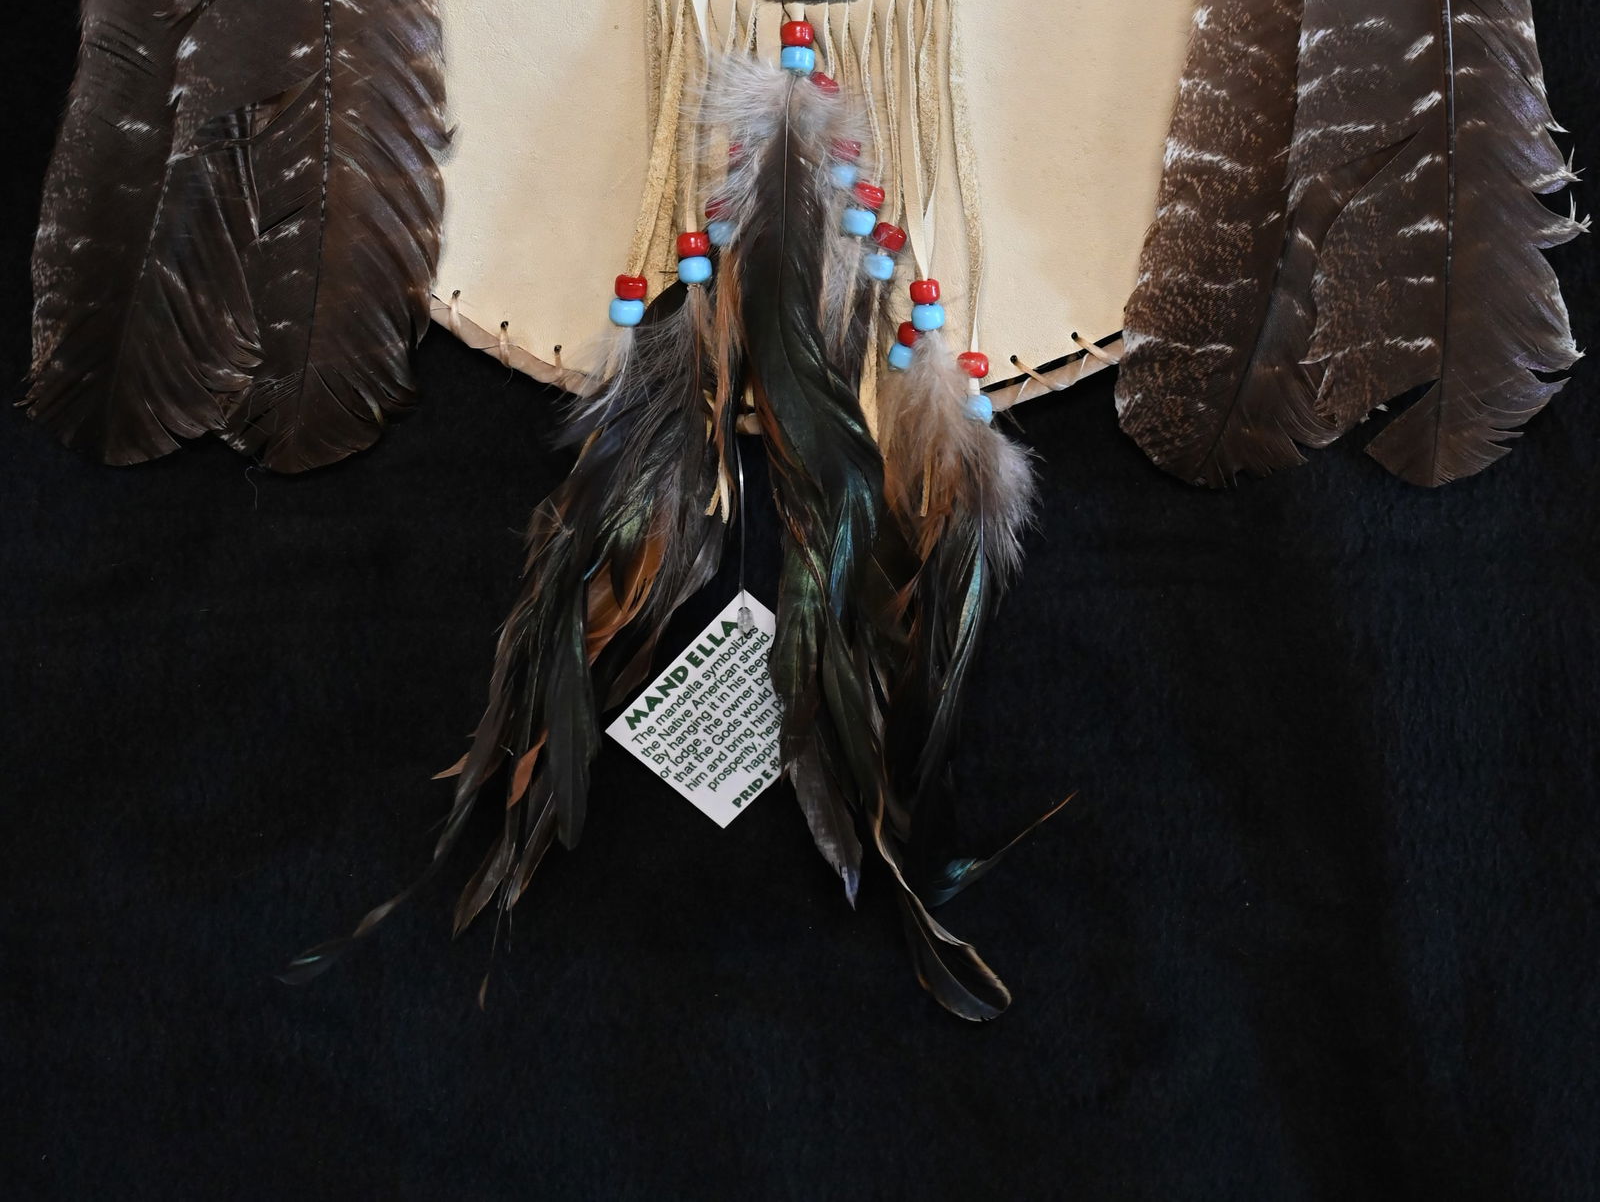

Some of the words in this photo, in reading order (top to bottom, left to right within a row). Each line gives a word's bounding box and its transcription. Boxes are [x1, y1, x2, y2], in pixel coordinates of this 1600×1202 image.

[625, 621, 738, 730] MANDELLA
[632, 726, 656, 745] The
[656, 680, 704, 726] mandella
[702, 626, 759, 681] symbolizes
[641, 741, 660, 758] the
[658, 709, 693, 741] Native
[692, 663, 741, 710] American
[739, 632, 773, 664] shield.
[652, 749, 671, 765] By
[667, 710, 712, 751] hanging
[707, 701, 719, 711] it
[715, 692, 730, 703] in
[727, 676, 746, 693] his
[660, 766, 672, 779] or
[670, 738, 707, 767] lodge,
[703, 718, 723, 735] the
[723, 685, 755, 718] owner
[673, 761, 697, 783] that
[694, 746, 713, 763] the
[712, 718, 742, 745] Gods
[740, 687, 773, 718] would
[685, 771, 708, 791] him
[707, 751, 728, 773] and
[724, 727, 756, 753] bring
[750, 708, 773, 728] him
[708, 742, 762, 792] prosperity,
[732, 770, 773, 808] PRIDE
